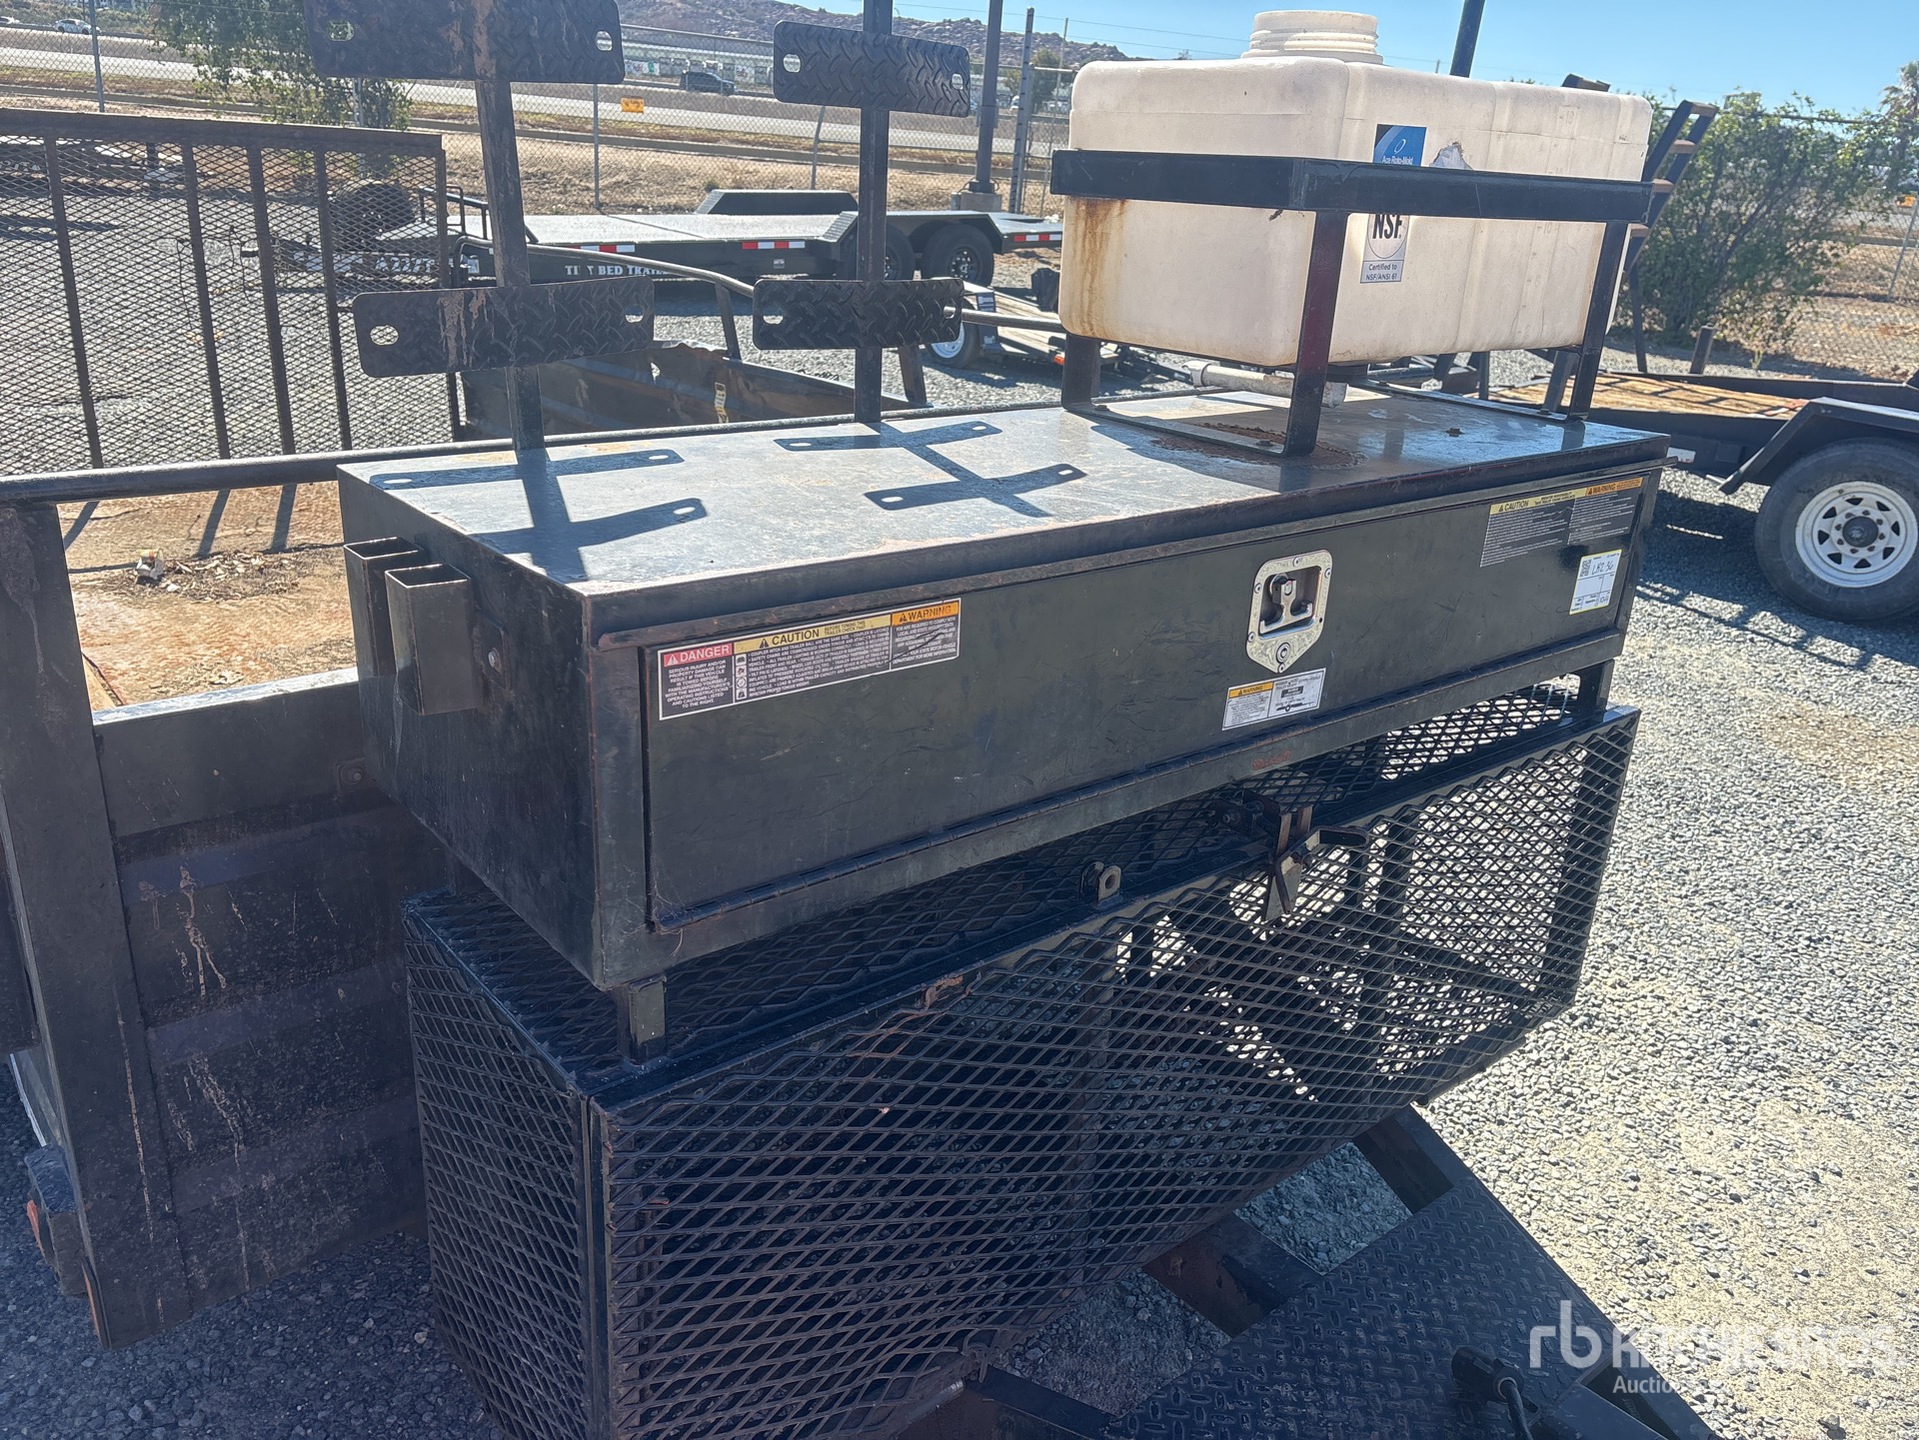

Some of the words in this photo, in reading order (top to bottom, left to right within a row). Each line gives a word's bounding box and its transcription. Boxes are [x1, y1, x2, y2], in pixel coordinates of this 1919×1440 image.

[1382, 156, 1391, 164] Ace
[1373, 214, 1402, 239] NSF
[598, 265, 624, 276] BED
[1504, 500, 1528, 512] CAUTION
[908, 605, 952, 620] WARNING
[772, 628, 820, 646] CAUTION
[680, 645, 729, 662] DANGER
[667, 694, 693, 702] OPERATING
